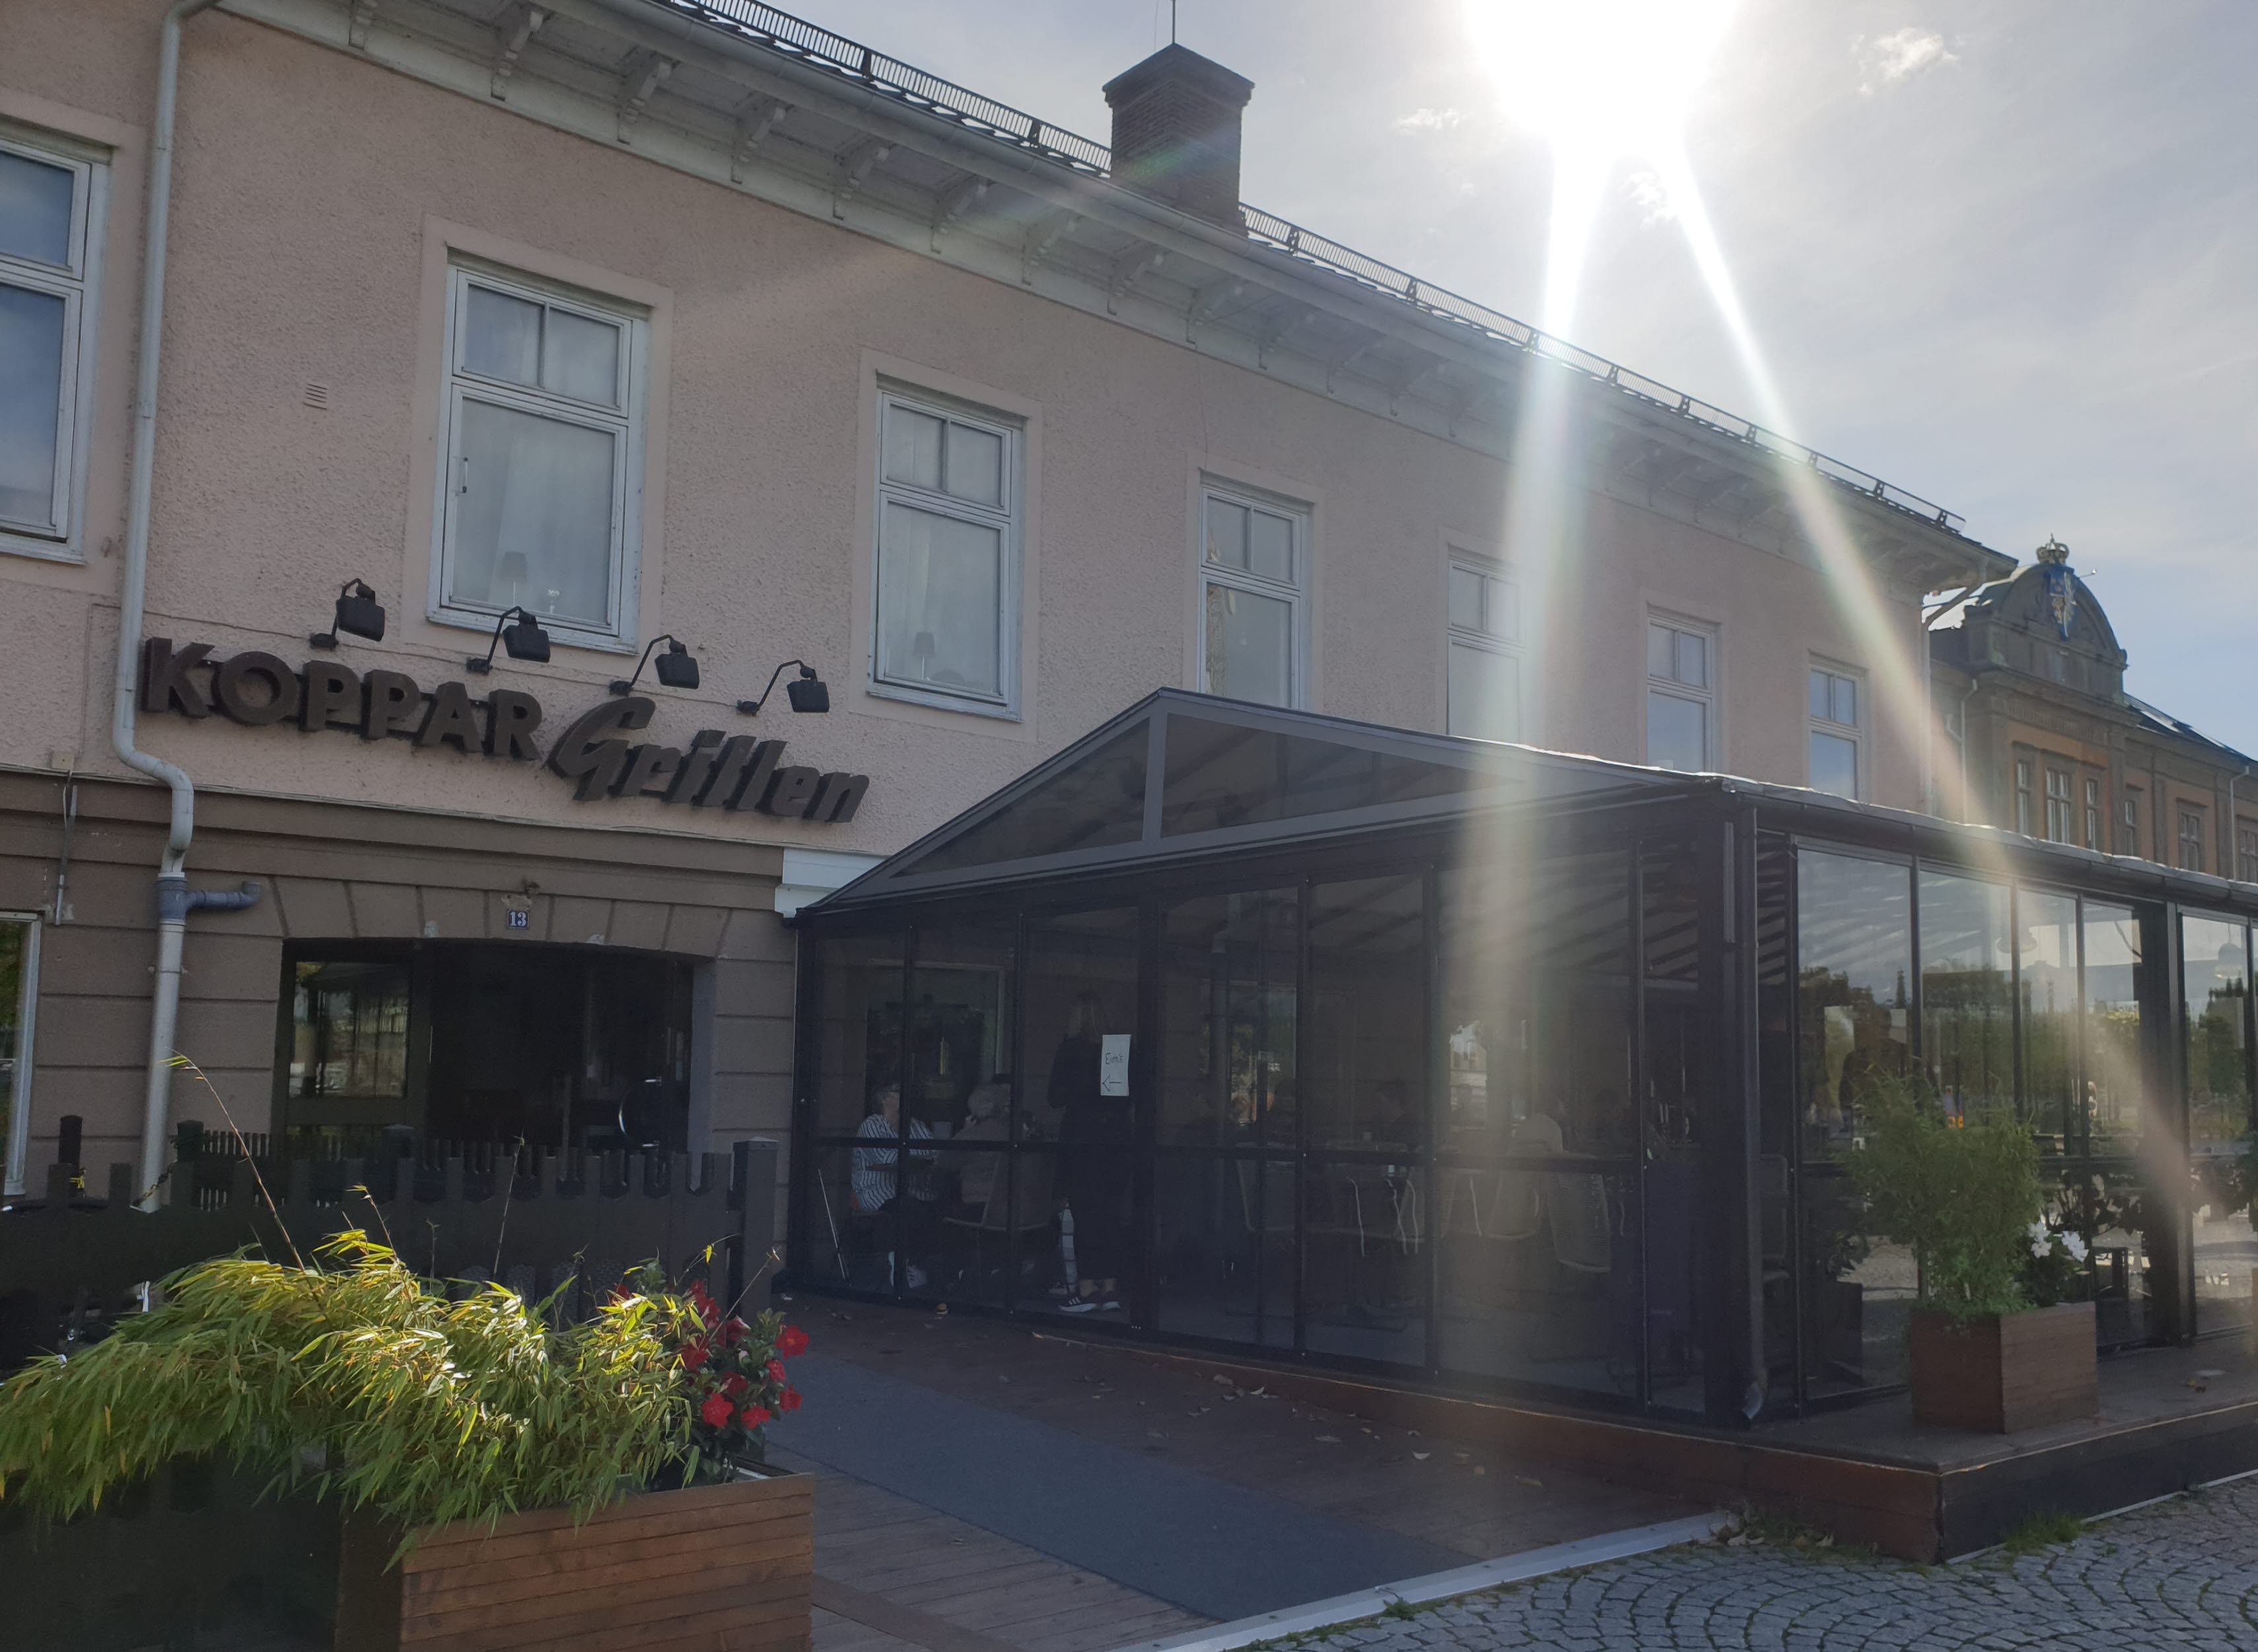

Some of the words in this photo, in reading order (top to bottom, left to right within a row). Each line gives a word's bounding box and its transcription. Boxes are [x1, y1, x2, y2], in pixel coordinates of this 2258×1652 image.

[143, 637, 541, 761] KOPPAR
[547, 697, 869, 823] Grillen
[509, 911, 526, 927] 13
